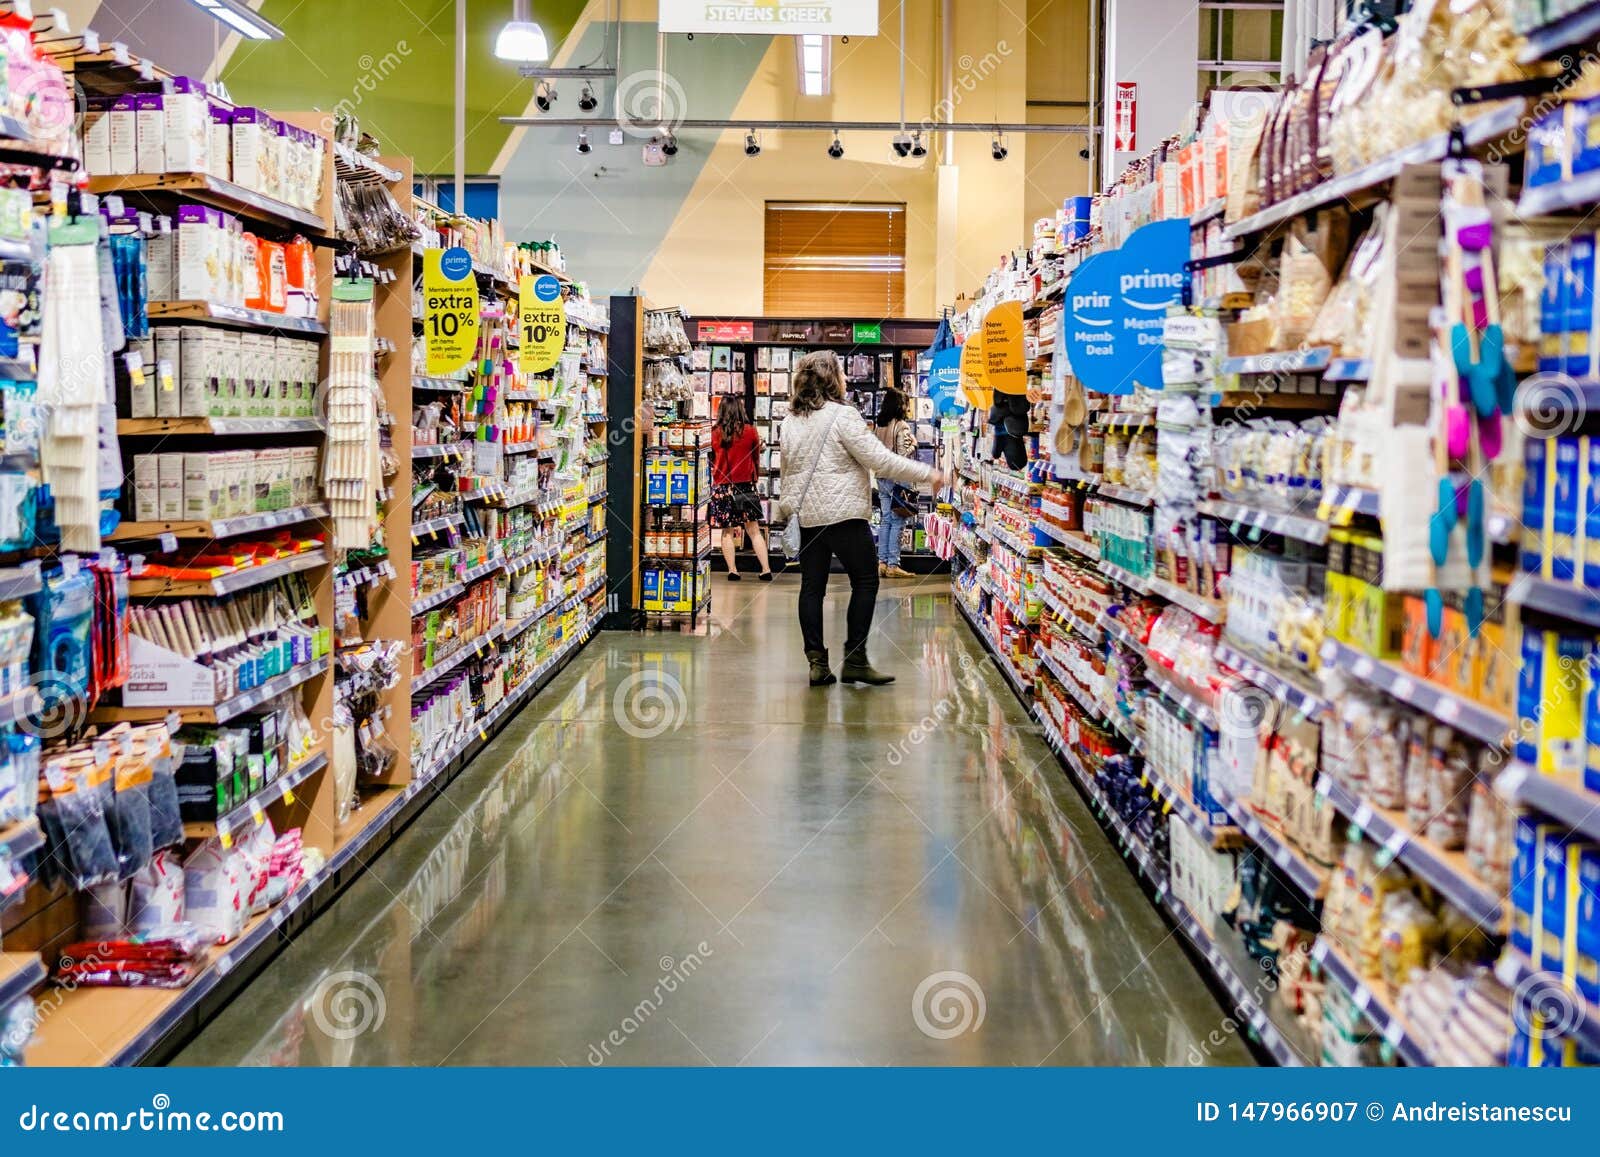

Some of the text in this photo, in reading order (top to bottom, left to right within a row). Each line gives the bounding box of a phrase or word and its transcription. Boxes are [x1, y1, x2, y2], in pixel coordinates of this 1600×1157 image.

[708, 7, 827, 22] STEVENS CREEK
[1119, 90, 1134, 99] FIRE
[445, 256, 467, 265] prime
[1120, 269, 1183, 294] prime
[428, 295, 473, 309] extra
[524, 312, 560, 323] extra
[429, 312, 474, 337] 10%
[523, 325, 560, 343] 10%
[987, 336, 1009, 344] prices.
[1086, 345, 1114, 355] Deal
[988, 359, 1004, 367] high
